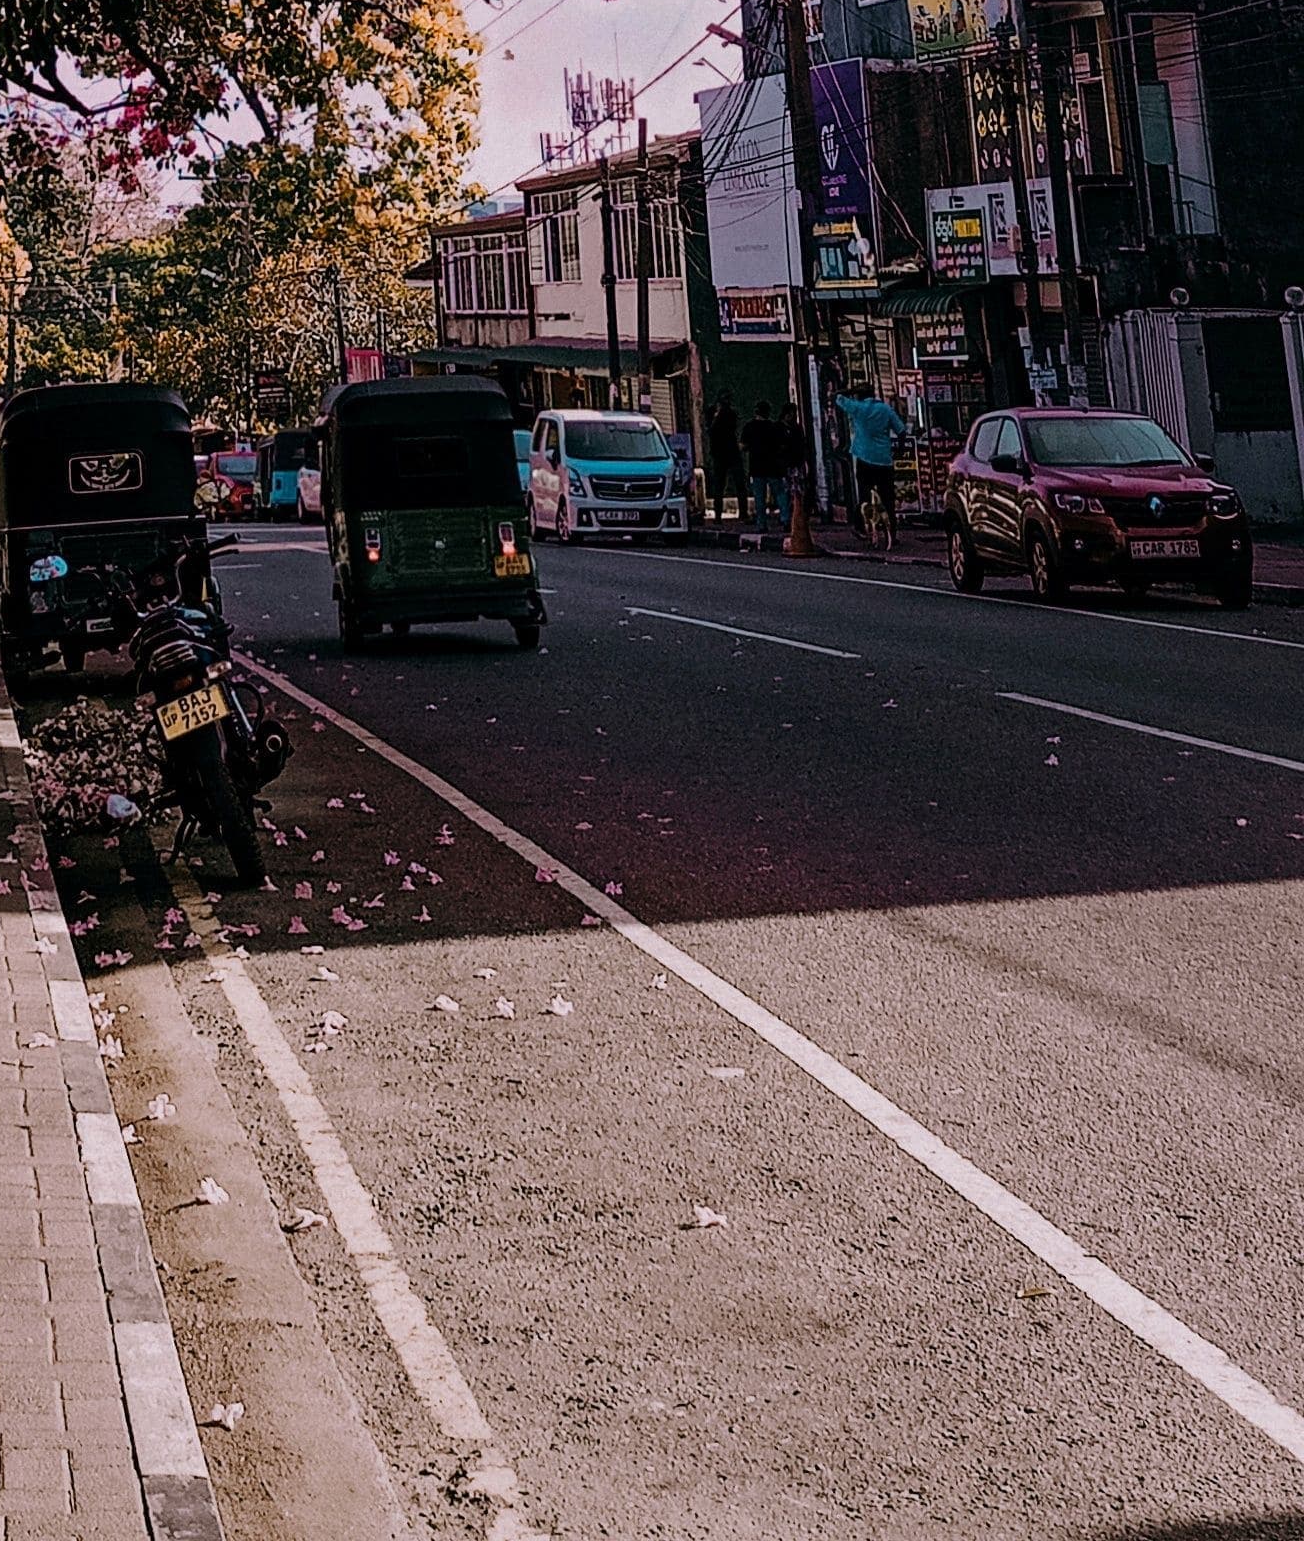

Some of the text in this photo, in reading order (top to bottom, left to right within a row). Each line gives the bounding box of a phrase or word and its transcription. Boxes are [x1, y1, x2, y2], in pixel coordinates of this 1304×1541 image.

[1142, 542, 1166, 554] CAR
[178, 689, 211, 713] BAJ
[163, 714, 178, 727] UP
[182, 703, 219, 729] 7152
